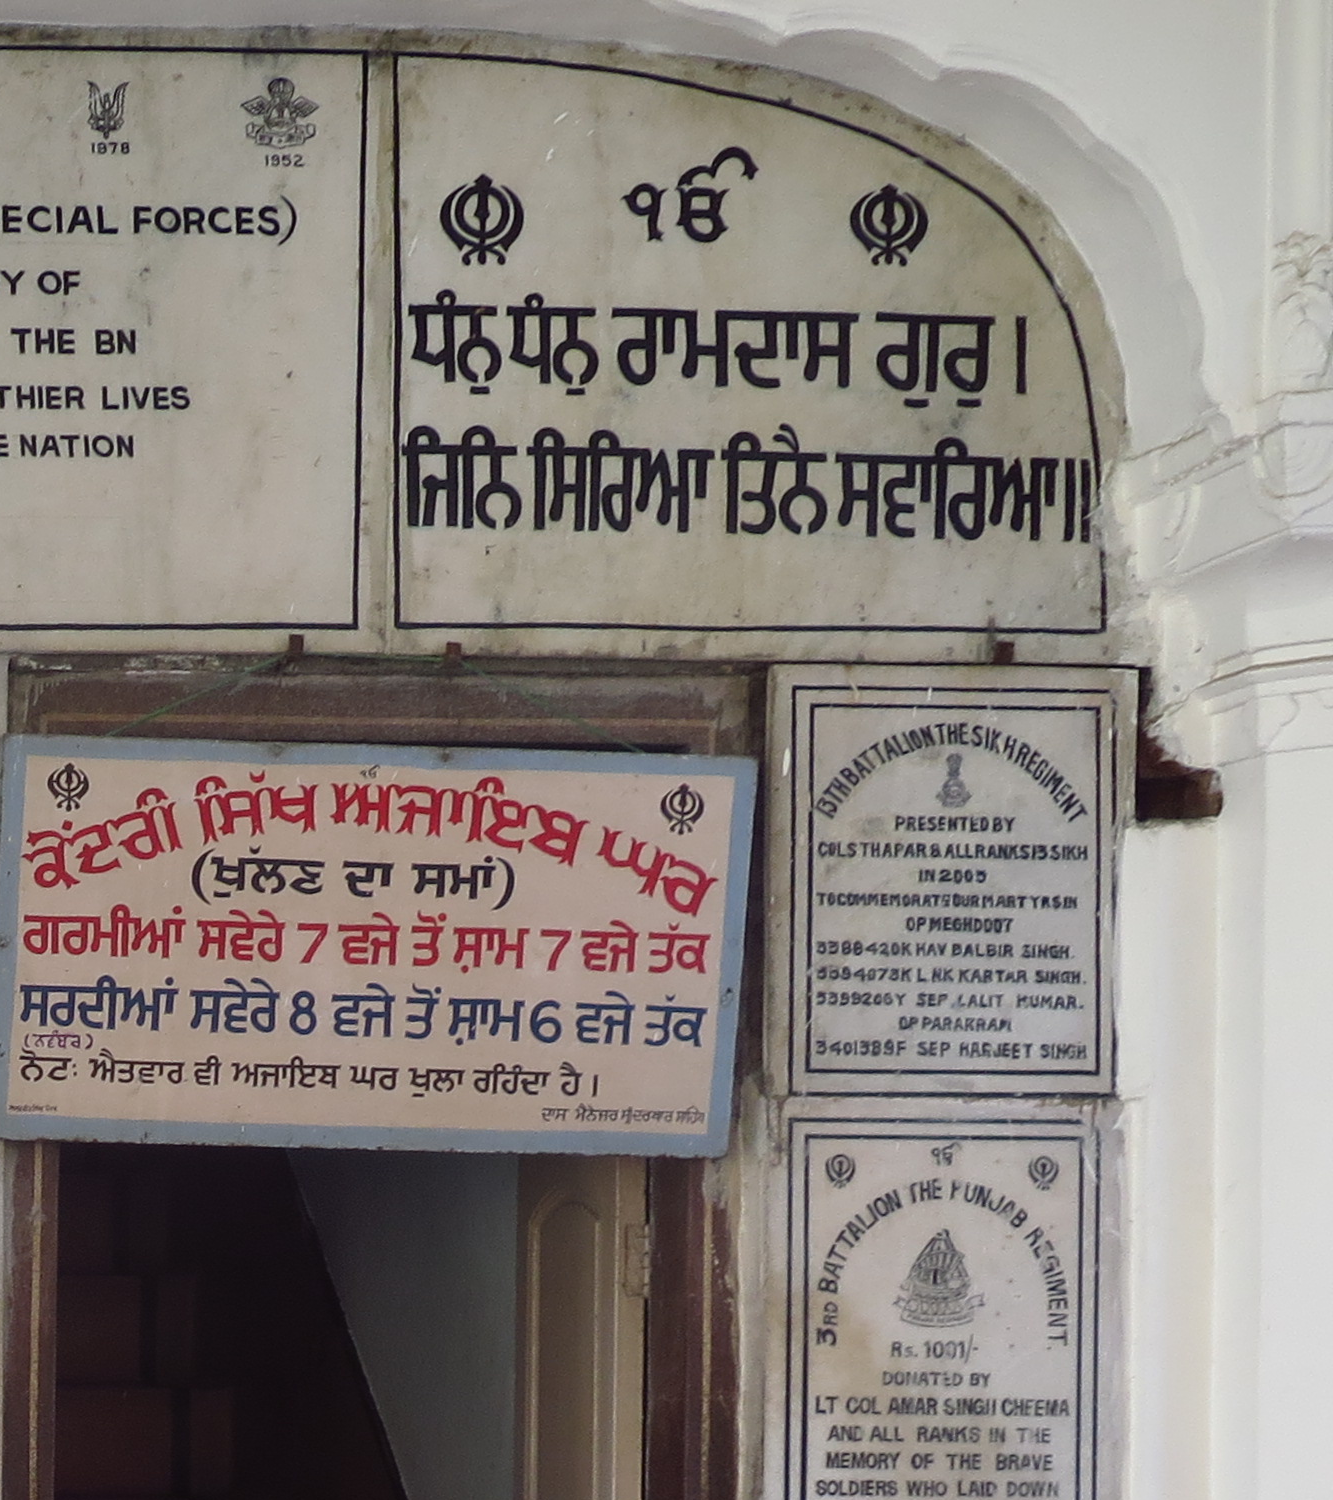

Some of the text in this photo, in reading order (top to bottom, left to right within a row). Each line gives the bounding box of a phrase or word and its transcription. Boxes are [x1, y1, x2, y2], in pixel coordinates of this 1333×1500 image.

[134, 196, 297, 245] FORCES)
[102, 386, 190, 410] LIVES
[895, 816, 1015, 833] PRESENTED BY
[826, 1452, 1052, 1471] MEMORY OF THE BRAVE
